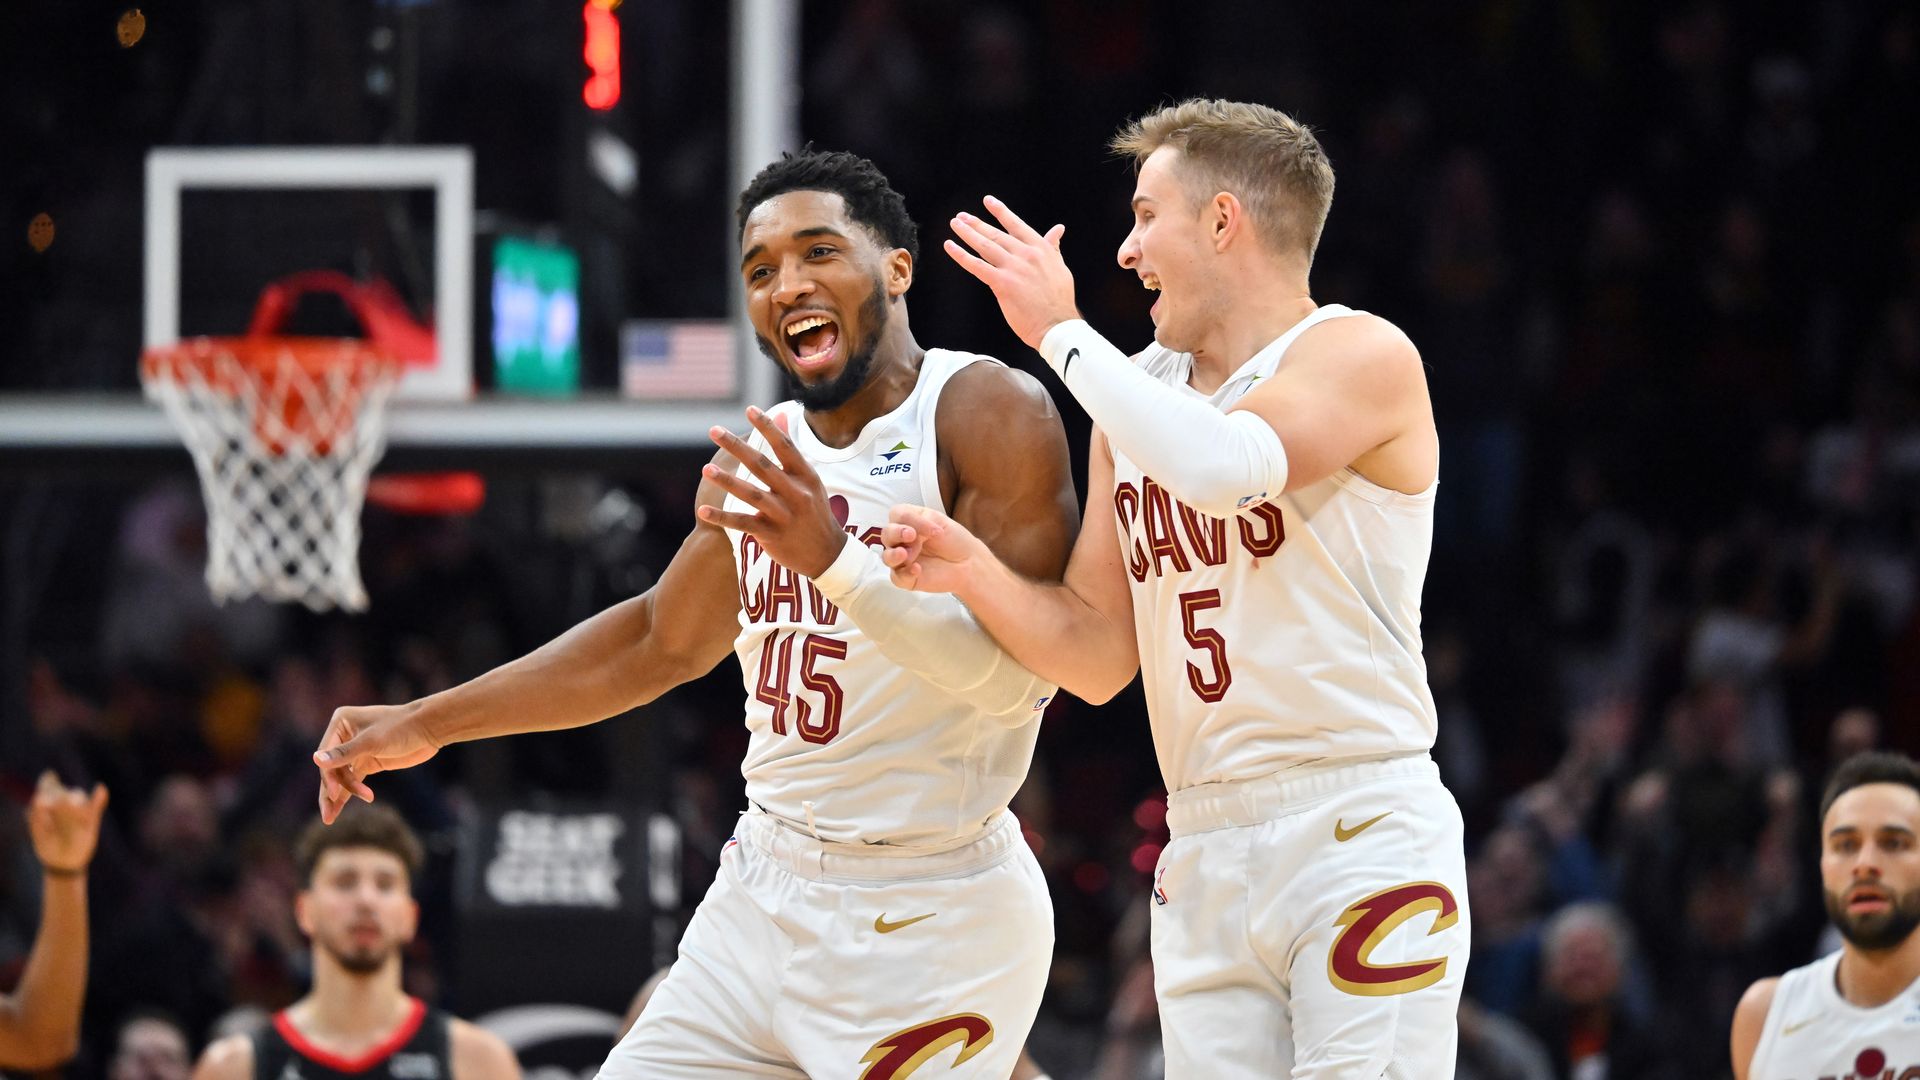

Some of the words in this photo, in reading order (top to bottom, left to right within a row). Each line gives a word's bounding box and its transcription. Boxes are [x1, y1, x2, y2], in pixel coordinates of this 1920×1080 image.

[870, 463, 911, 476] CLIFFS
[755, 628, 848, 745] 45
[1178, 588, 1232, 704] 5
